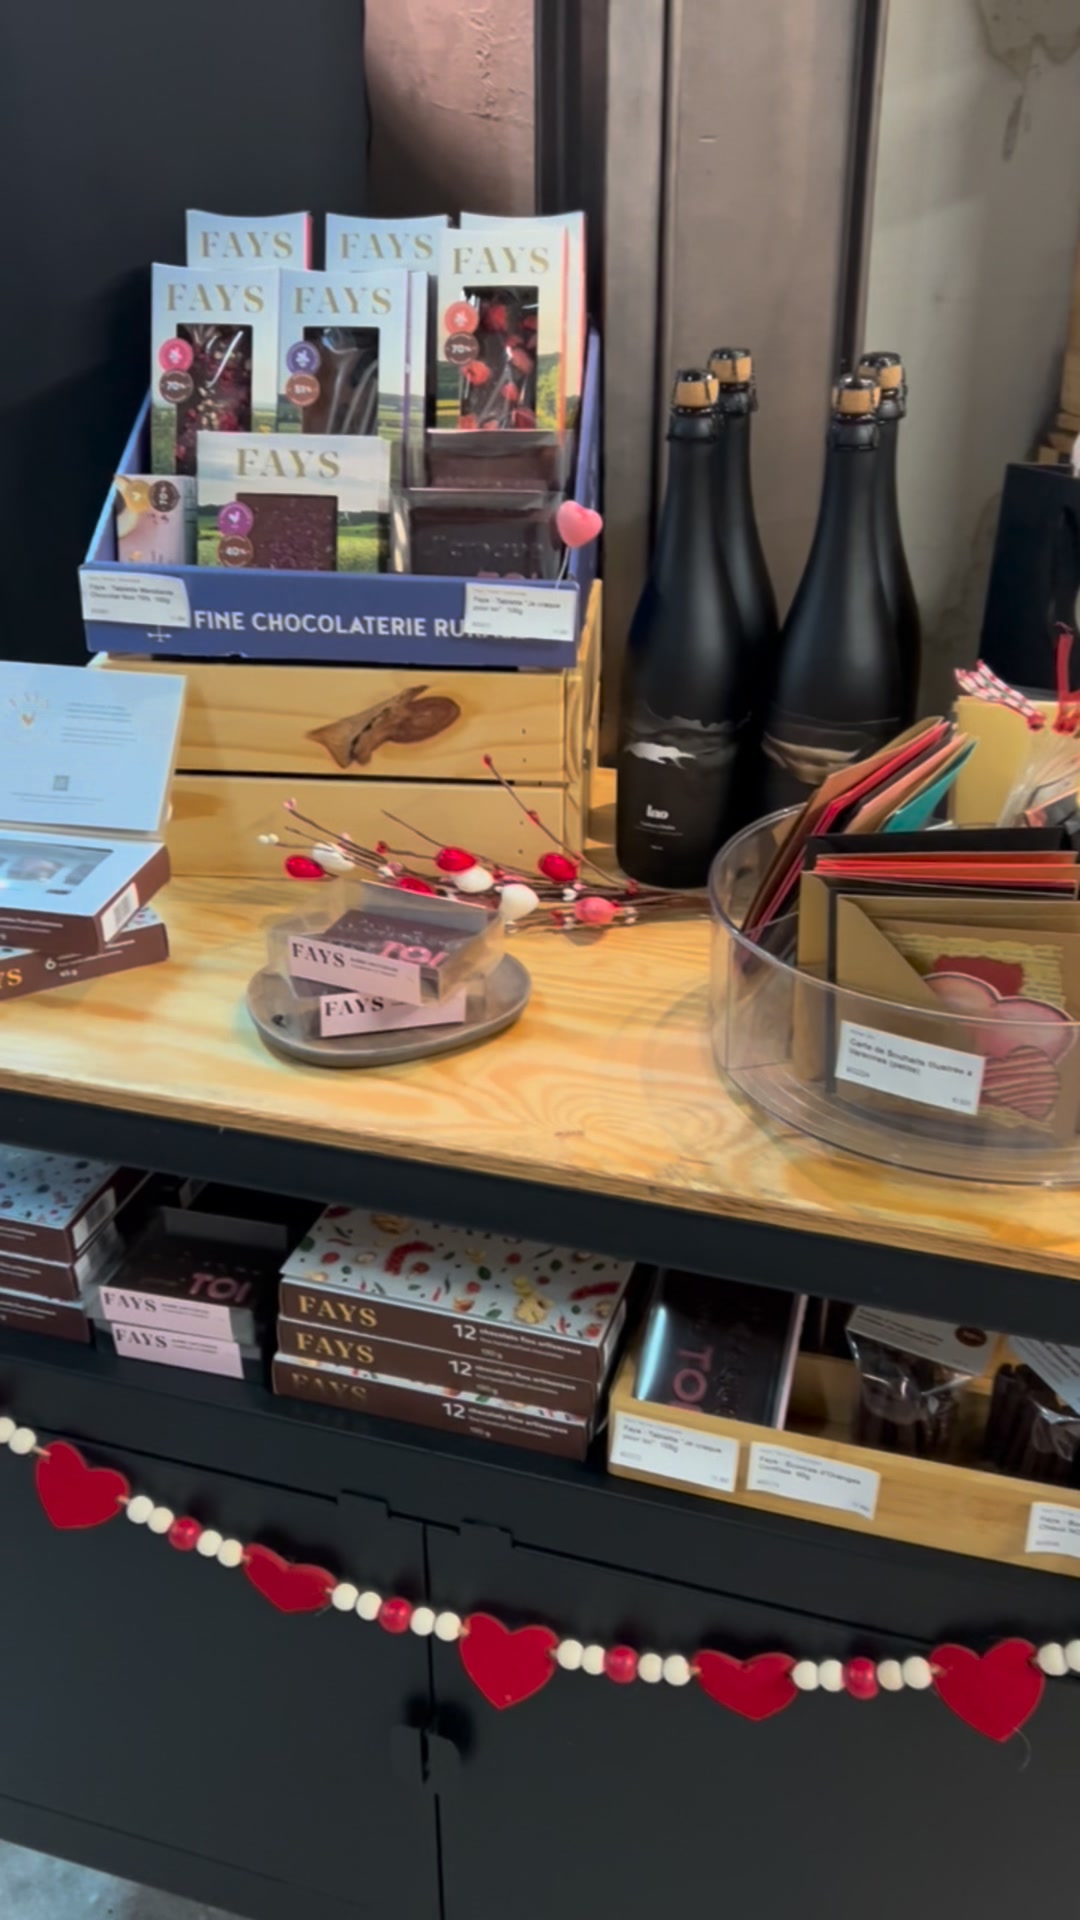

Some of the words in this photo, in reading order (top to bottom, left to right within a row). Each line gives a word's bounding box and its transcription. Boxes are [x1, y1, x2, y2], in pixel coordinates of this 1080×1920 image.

[201, 231, 294, 259] FAYS
[341, 233, 433, 259] FAYS
[452, 247, 549, 274] FAYS
[167, 283, 264, 313] FAYS
[293, 286, 392, 315] FAYS
[236, 448, 340, 479] FAYS
[194, 610, 245, 631] FINE
[251, 613, 427, 637] CHOCOLATERIE
[45, 958, 56, 970] 6
[292, 942, 346, 968] FAYS
[324, 996, 385, 1017] FAYS
[189, 1273, 250, 1303] TOI
[103, 1292, 157, 1313] FAYS
[298, 1294, 378, 1328] FAYS
[115, 1328, 168, 1349] FAYS
[452, 1323, 477, 1341] 12
[296, 1332, 375, 1364] FAYS
[448, 1359, 473, 1377] 12
[291, 1372, 367, 1400] FAYS
[441, 1402, 466, 1420] 12
